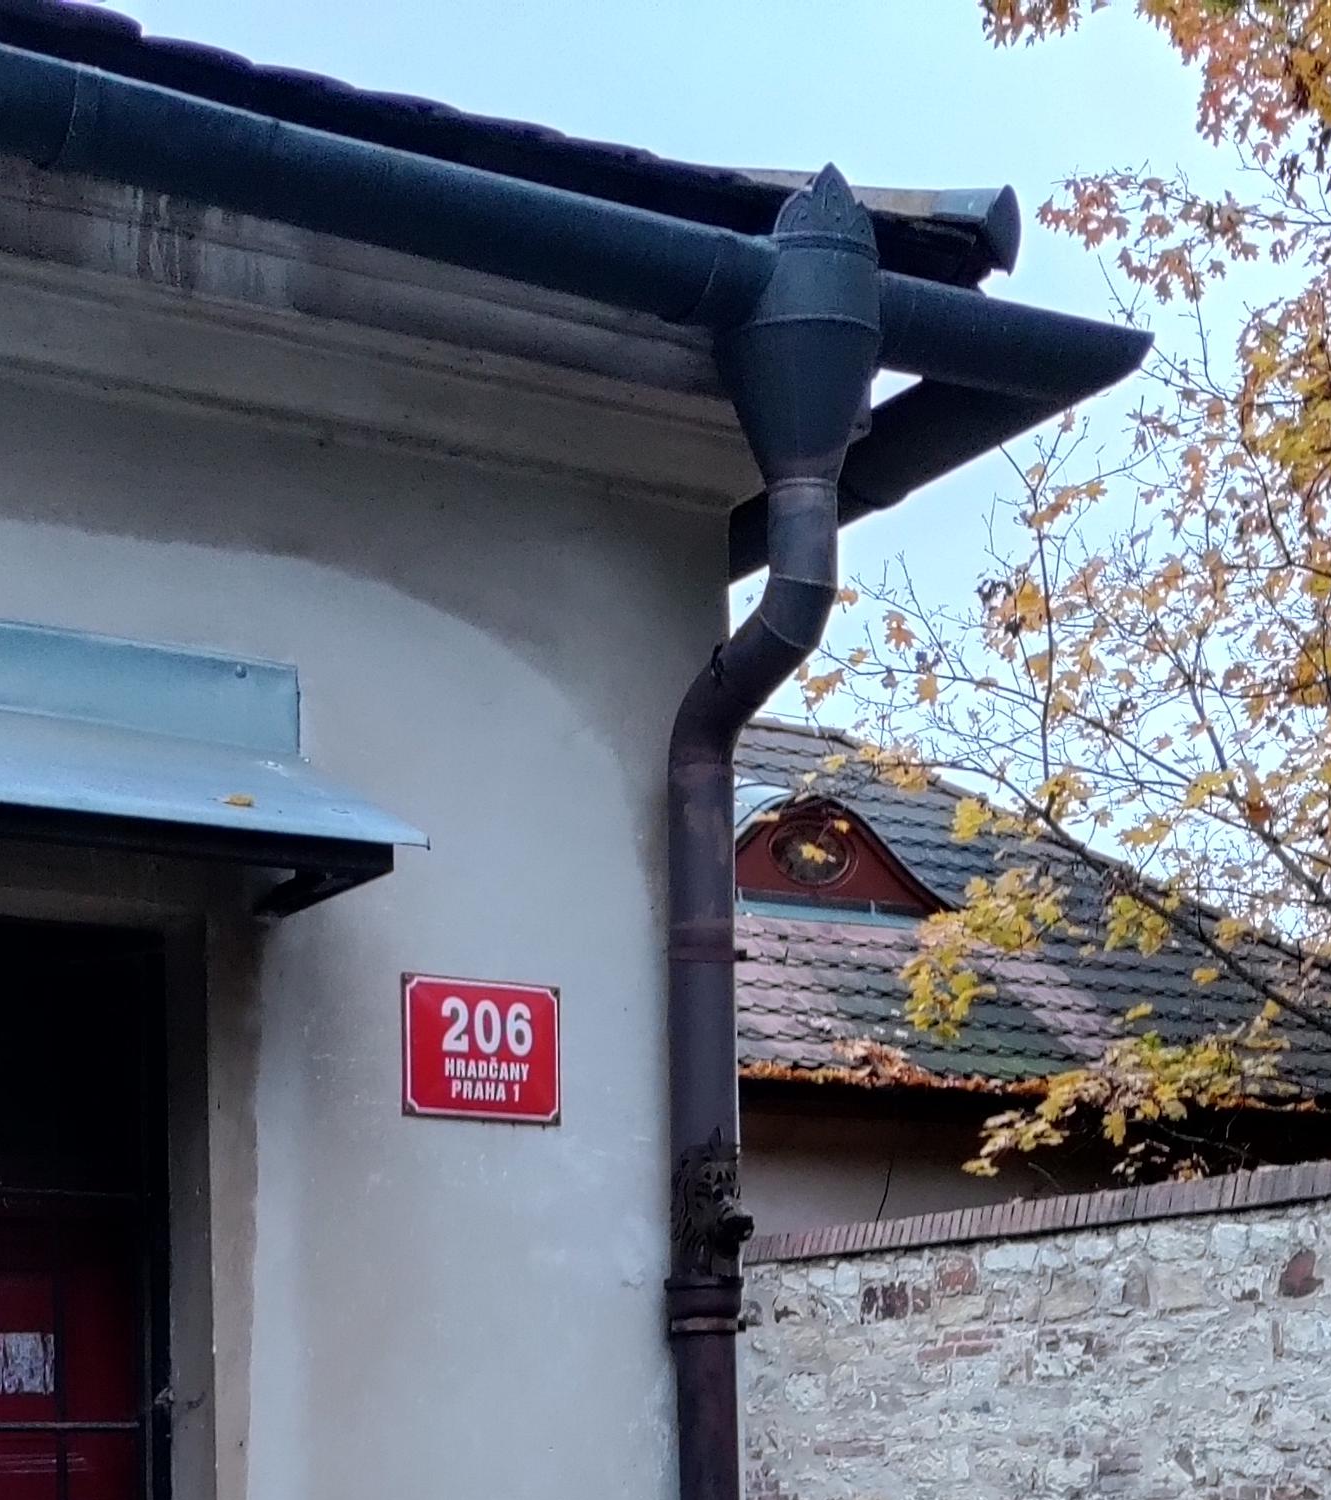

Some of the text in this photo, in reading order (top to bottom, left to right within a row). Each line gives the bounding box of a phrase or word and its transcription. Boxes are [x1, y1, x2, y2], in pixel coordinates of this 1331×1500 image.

[441, 996, 533, 1057] 206
[444, 1056, 530, 1083] HRADČANY
[451, 1079, 521, 1103] PRAHA 1
